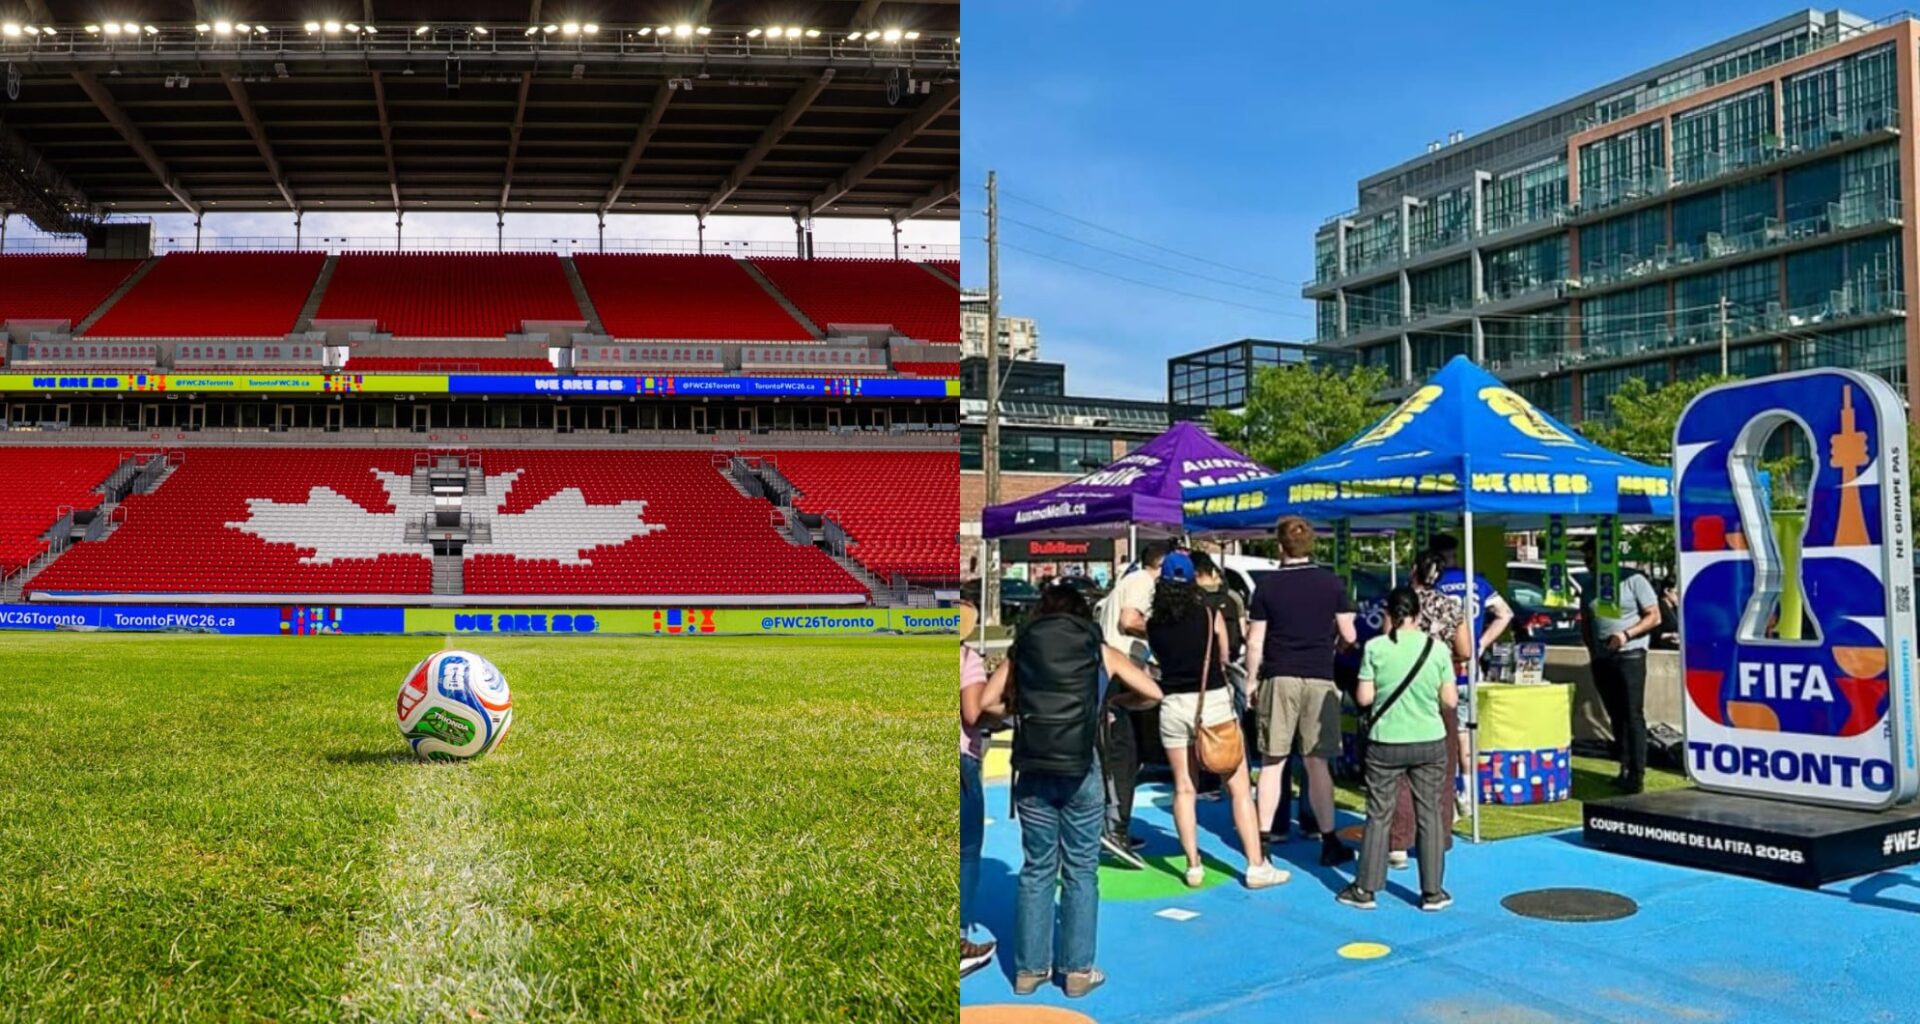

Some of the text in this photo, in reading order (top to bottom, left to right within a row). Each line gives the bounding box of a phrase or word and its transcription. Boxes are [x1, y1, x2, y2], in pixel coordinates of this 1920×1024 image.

[33, 377, 119, 388] WE ARE 26
[535, 379, 623, 390] WE ARE 26
[682, 382, 741, 390] @FWC26Toronto
[754, 382, 816, 390] TorontoFWC26.ca
[1182, 458, 1261, 474] Ausma
[1471, 473, 1507, 493] WE
[1508, 473, 1552, 494] ARE
[114, 613, 236, 627] TorontoFWC26.ca
[454, 614, 596, 632] WE ARE 26
[761, 616, 875, 630] @FWC26Toronto
[1738, 661, 1835, 702] FIFA
[1687, 741, 1895, 792] TORONTO
[1589, 816, 1805, 864] COUPE DU MONDE DE LA FIFA 2026
